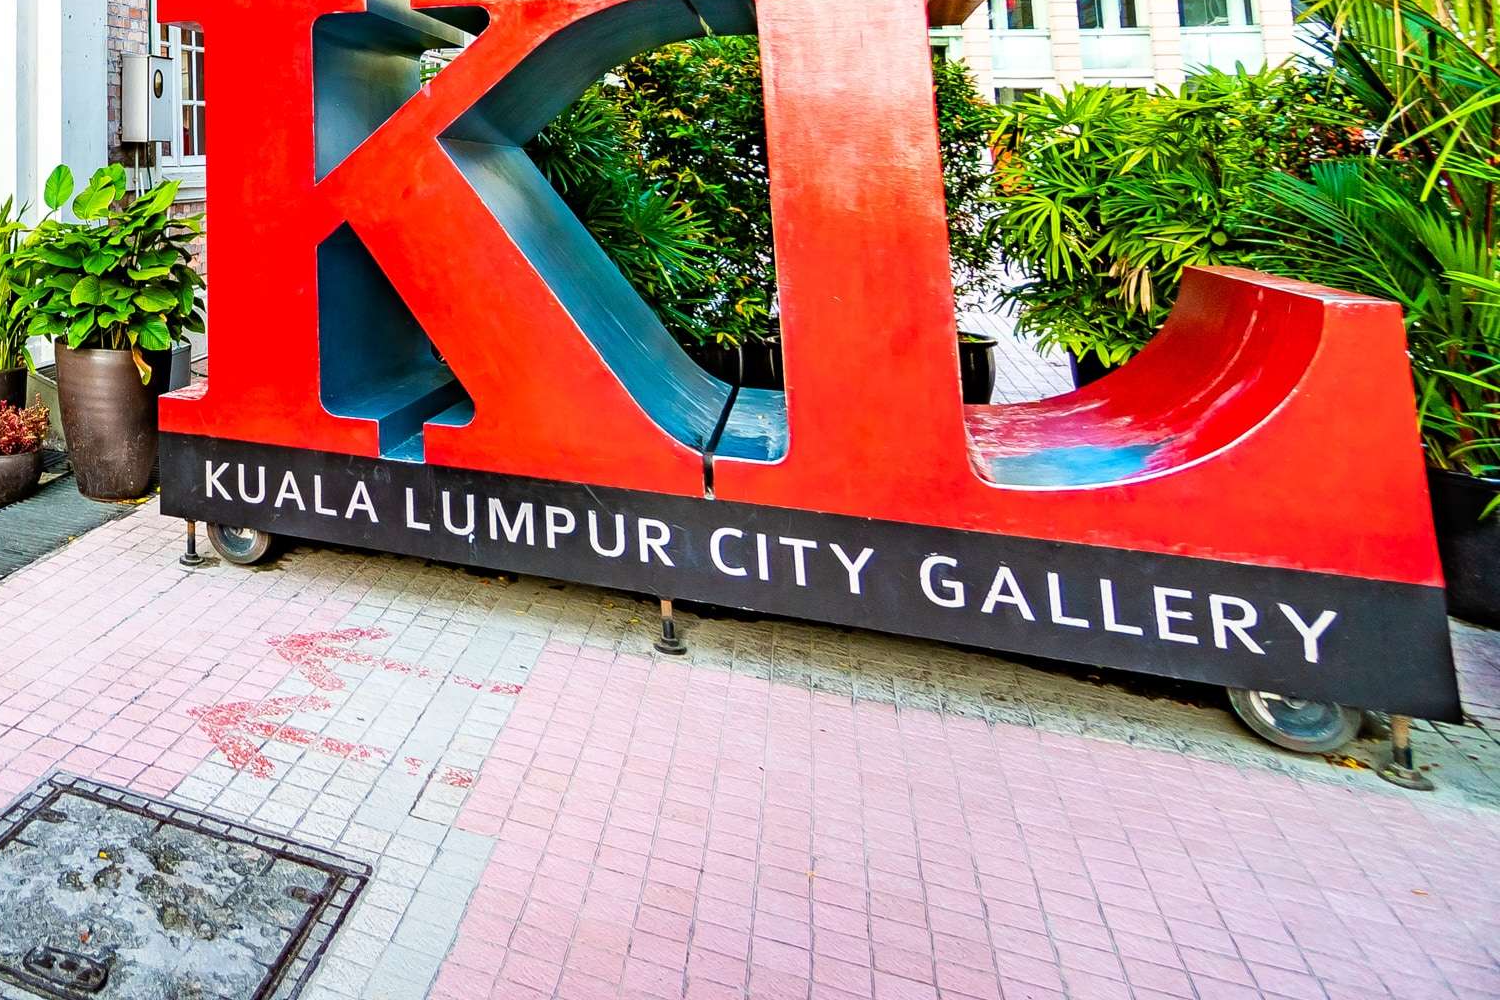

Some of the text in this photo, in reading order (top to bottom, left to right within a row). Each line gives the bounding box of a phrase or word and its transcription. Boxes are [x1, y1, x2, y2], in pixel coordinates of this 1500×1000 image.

[204, 460, 1338, 664] KUALA LUMPUR CITY GALLERY
